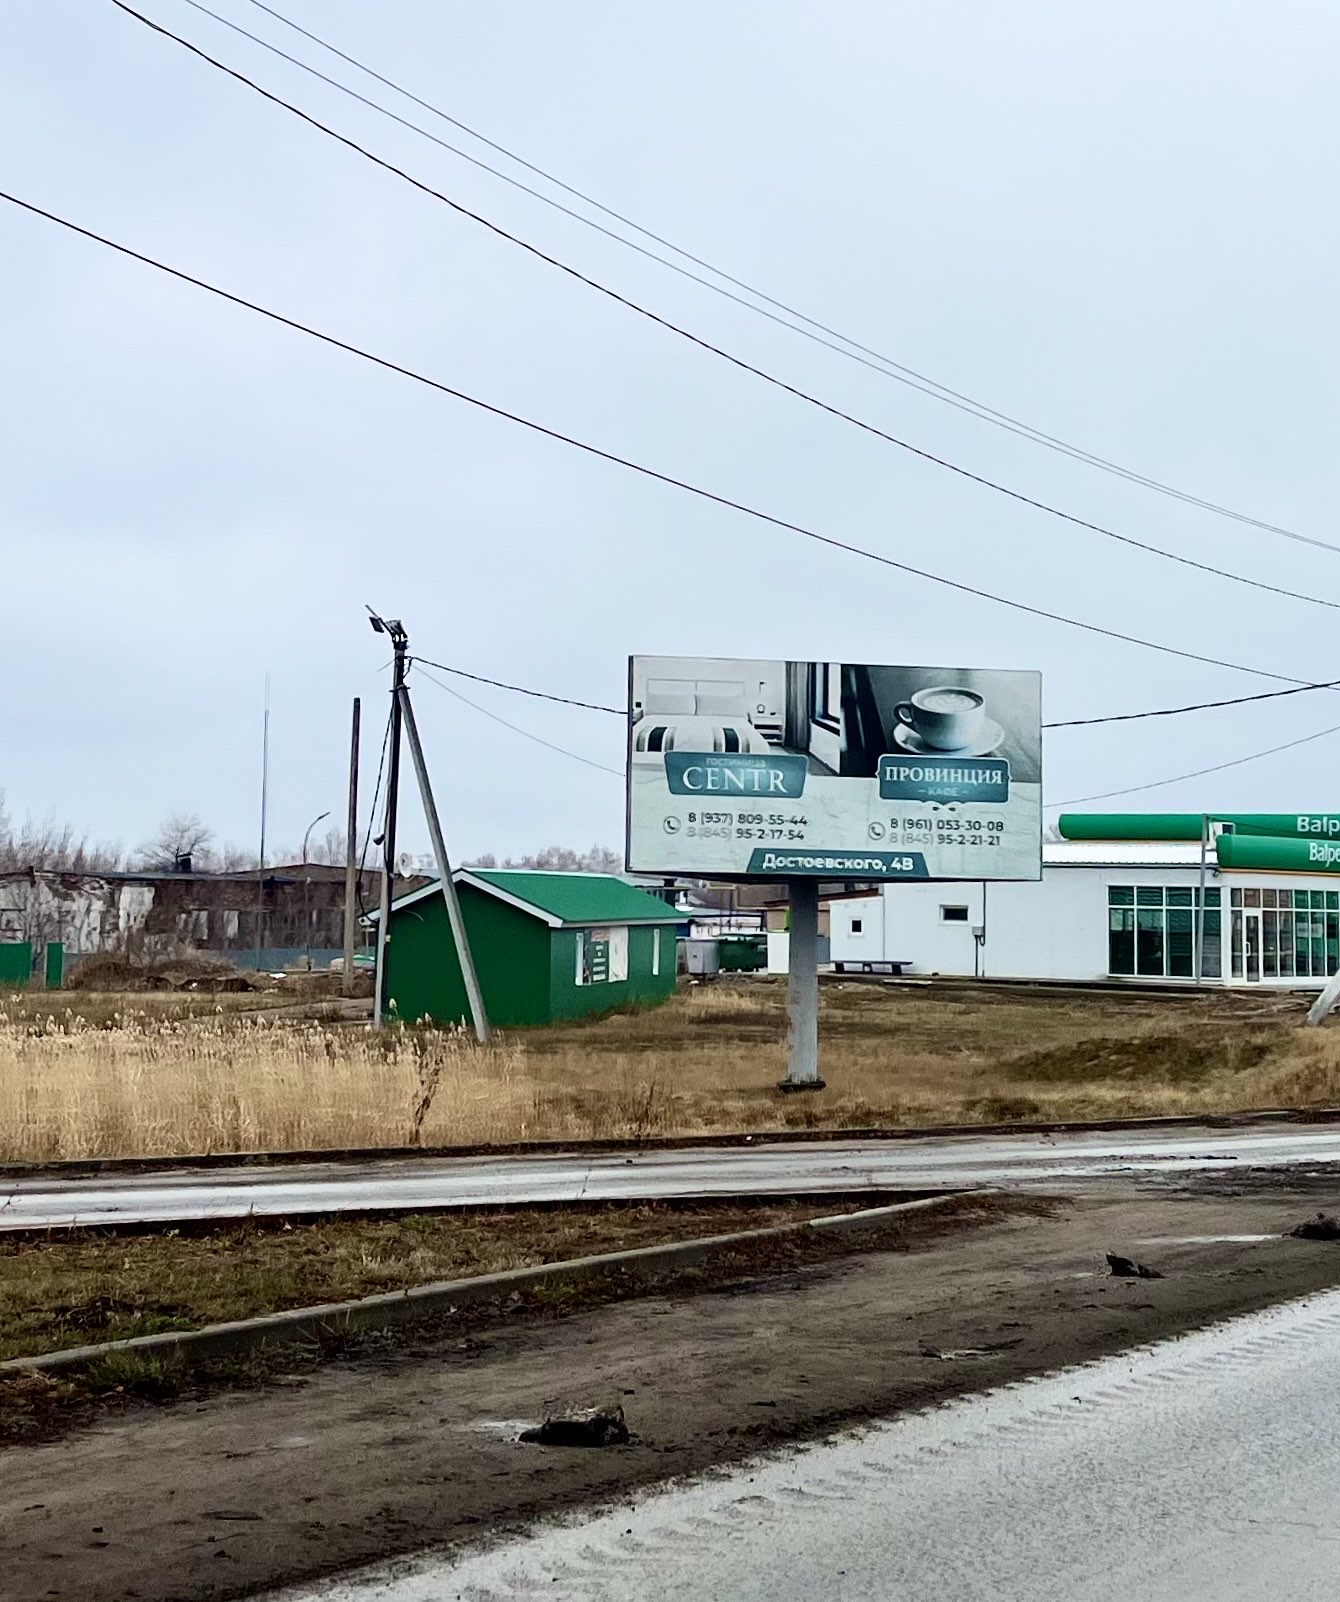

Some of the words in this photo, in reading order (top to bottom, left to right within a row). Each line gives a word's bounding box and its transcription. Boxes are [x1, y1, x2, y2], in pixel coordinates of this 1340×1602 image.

[682, 766, 789, 793] CENTR
[885, 766, 1003, 786] ПРОВИНЦИЯ
[688, 812, 697, 823] 8
[701, 812, 733, 825] (937)
[737, 814, 808, 826] 809-55-44
[890, 818, 898, 829] 8
[902, 818, 933, 832] (961)
[936, 820, 1004, 832] 053-30-08
[736, 828, 805, 840] 95-2-17-54
[937, 834, 1001, 846] 95-2-21-21
[762, 853, 887, 872] Достоевского,
